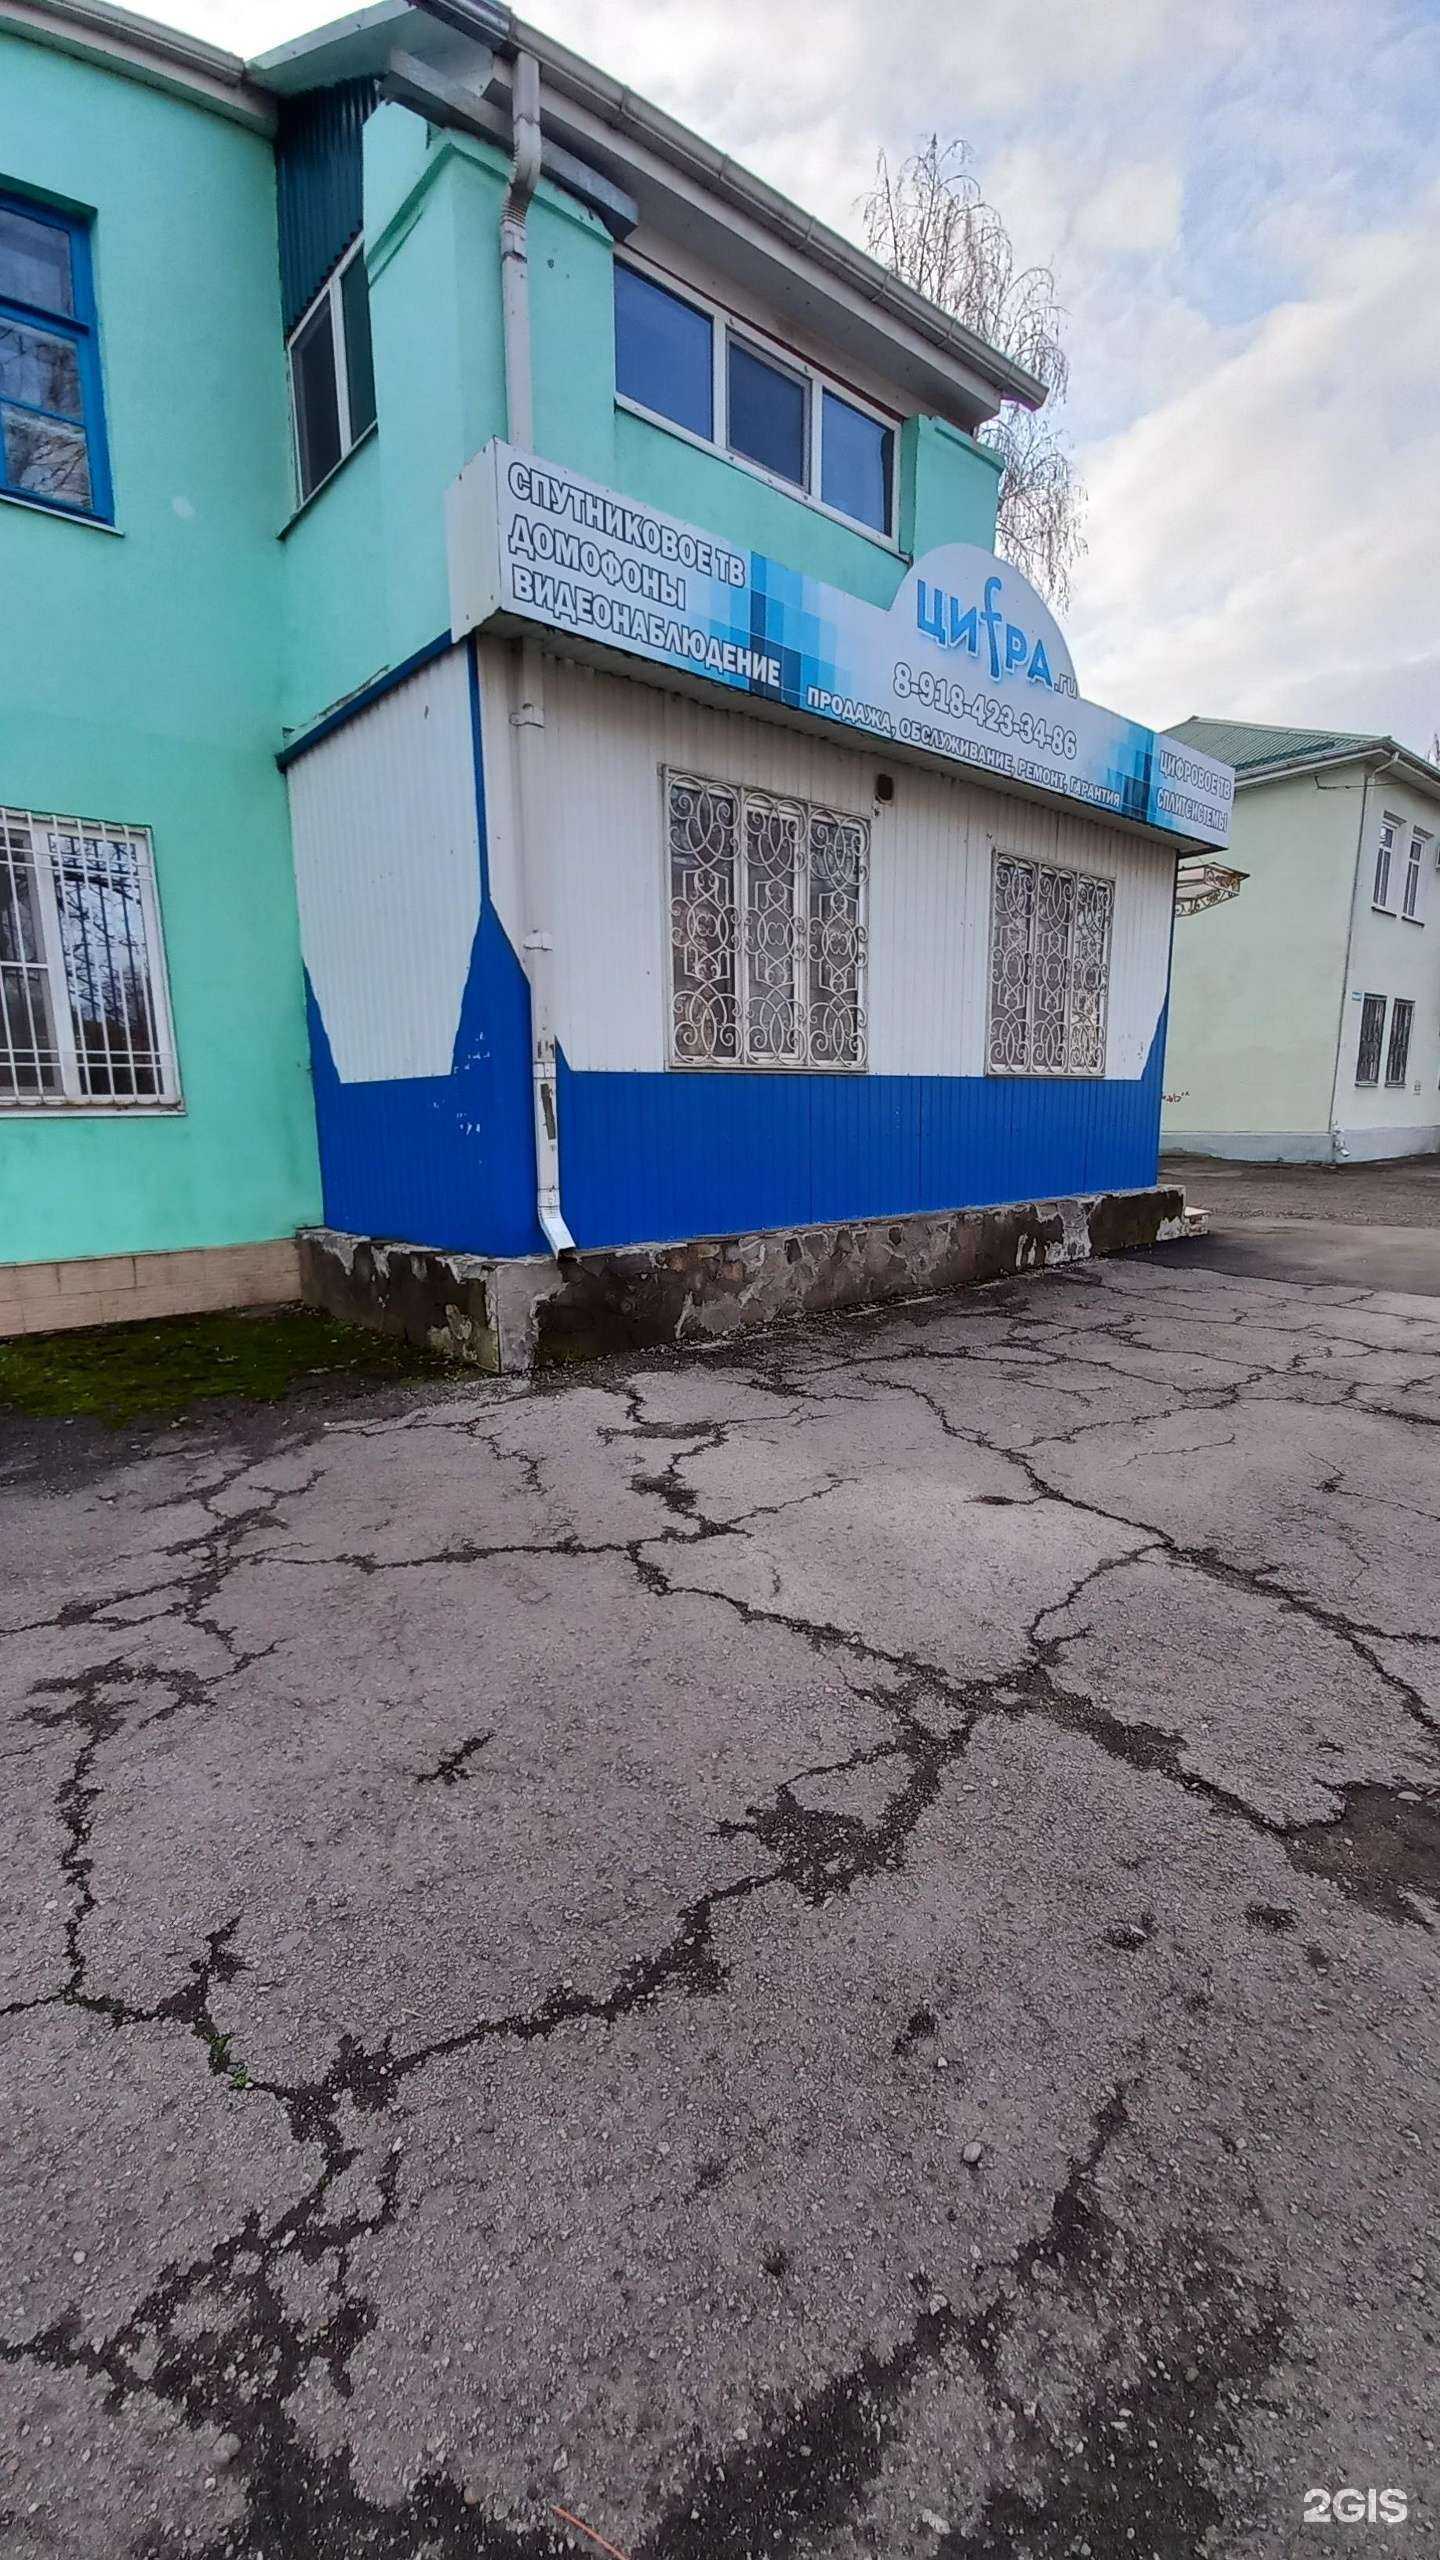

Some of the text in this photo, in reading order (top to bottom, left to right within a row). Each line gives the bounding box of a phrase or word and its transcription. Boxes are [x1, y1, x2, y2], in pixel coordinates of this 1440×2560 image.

[508, 462, 745, 588] СПУТНИКОВОЕ ТВ
[508, 514, 686, 611] ДОМОФОНЫ
[512, 564, 781, 687] ВИДЕОНАБЛЮДЕНИЕ
[807, 685, 1120, 808] ПРОДАЖА, ОБСЛУЖИВАНИЕ, РЕМОНТ, ГАРАНТИЯ
[893, 662, 1077, 760] 8-918-423-34-86
[1160, 749, 1218, 796] ЦИФРОВОЕ
